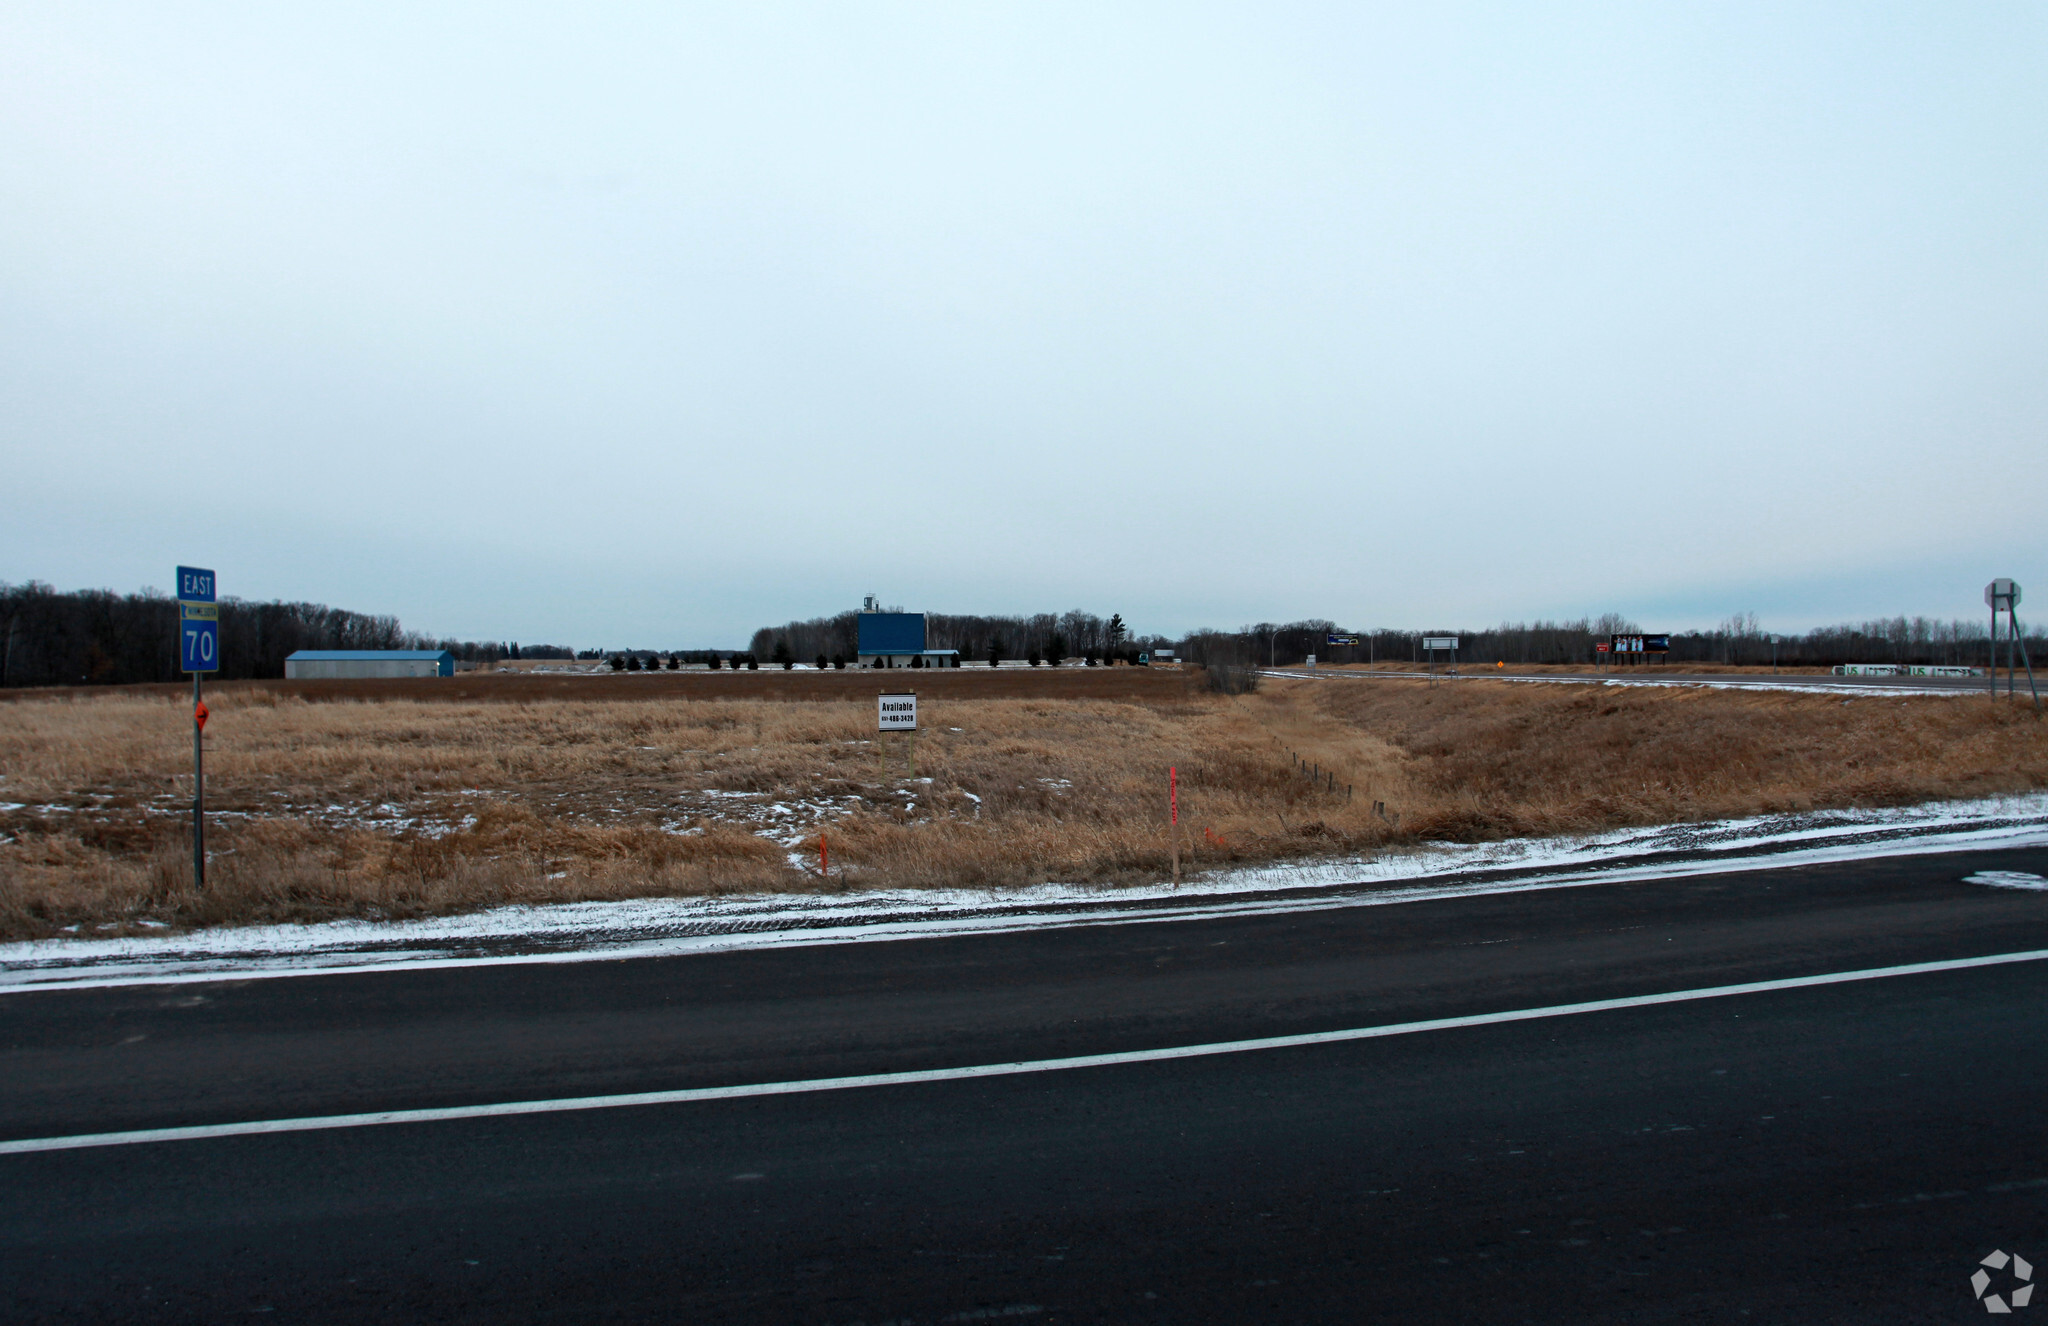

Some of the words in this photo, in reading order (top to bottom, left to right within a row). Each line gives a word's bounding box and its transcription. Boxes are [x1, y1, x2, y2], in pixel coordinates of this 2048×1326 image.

[184, 574, 211, 595] EAST
[186, 630, 213, 661] 70
[882, 702, 913, 712] Available
